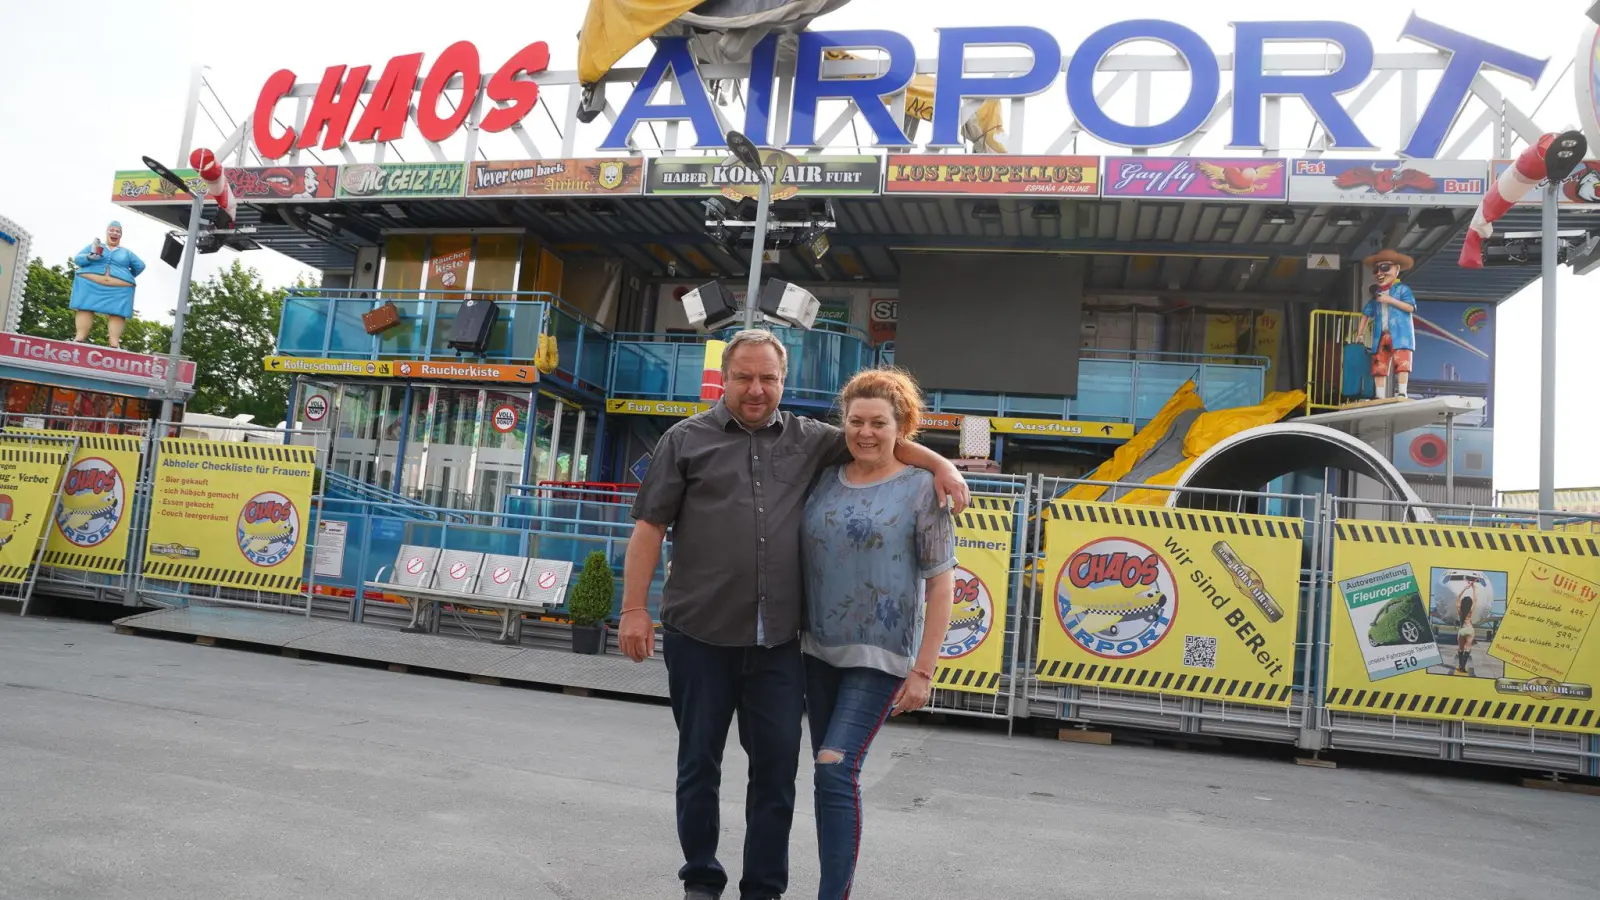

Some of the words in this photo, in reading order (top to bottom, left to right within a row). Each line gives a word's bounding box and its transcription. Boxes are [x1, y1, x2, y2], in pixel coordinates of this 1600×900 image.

[597, 9, 1552, 160] AIRPORT
[252, 40, 551, 160] CHAOS
[663, 172, 707, 183] HABER
[781, 165, 823, 184] AIR
[825, 172, 862, 183] FURT
[895, 163, 940, 181] LOS
[944, 163, 1084, 184] PROPELLOS
[1296, 160, 1326, 175] Fat
[387, 168, 426, 191] GEIZ
[430, 168, 463, 191] FLY
[474, 165, 509, 190] Never
[510, 168, 533, 182] com
[536, 162, 565, 177] back
[1058, 185, 1091, 193] AIRLINE
[1444, 179, 1481, 193] Bull
[432, 250, 467, 266] Raucher
[10, 337, 80, 364] Ticket
[283, 359, 363, 374] Kofferschnüffler
[421, 364, 500, 378] Raucherkiste
[310, 400, 324, 408] VOLL
[627, 402, 651, 412] Fun
[656, 403, 687, 414] Gate
[692, 405, 699, 414] 1
[498, 411, 514, 419] VOLL
[1013, 421, 1083, 434] Ausflug
[163, 458, 199, 469] Abholer
[201, 461, 253, 473] Checkliste
[255, 464, 270, 475] für
[272, 466, 311, 477] Frauen:
[18, 473, 49, 484] Verbot
[165, 475, 180, 484] Bier
[181, 476, 209, 486] gekauft
[164, 487, 178, 495] sich
[180, 488, 206, 498] hübsch
[207, 491, 240, 502] gemacht
[162, 498, 184, 507] Essen
[185, 500, 214, 510] gekocht
[244, 500, 292, 524] CHAOS
[161, 509, 183, 518] Couch
[184, 510, 229, 522] leergeräumt
[1069, 552, 1159, 588] CHAOS
[1232, 563, 1255, 587] KORN
[1346, 567, 1408, 590] Autovermietung
[1352, 581, 1411, 604] Fleuropcar
[1553, 573, 1578, 593] Uiii
[1580, 584, 1598, 603] fly
[1059, 594, 1170, 655] AIRPORT
[1190, 569, 1231, 610] sind
[1225, 608, 1283, 678] BEReit
[1394, 656, 1418, 671] E10
[1522, 683, 1549, 693] KORN
[1552, 685, 1568, 694] AIR
